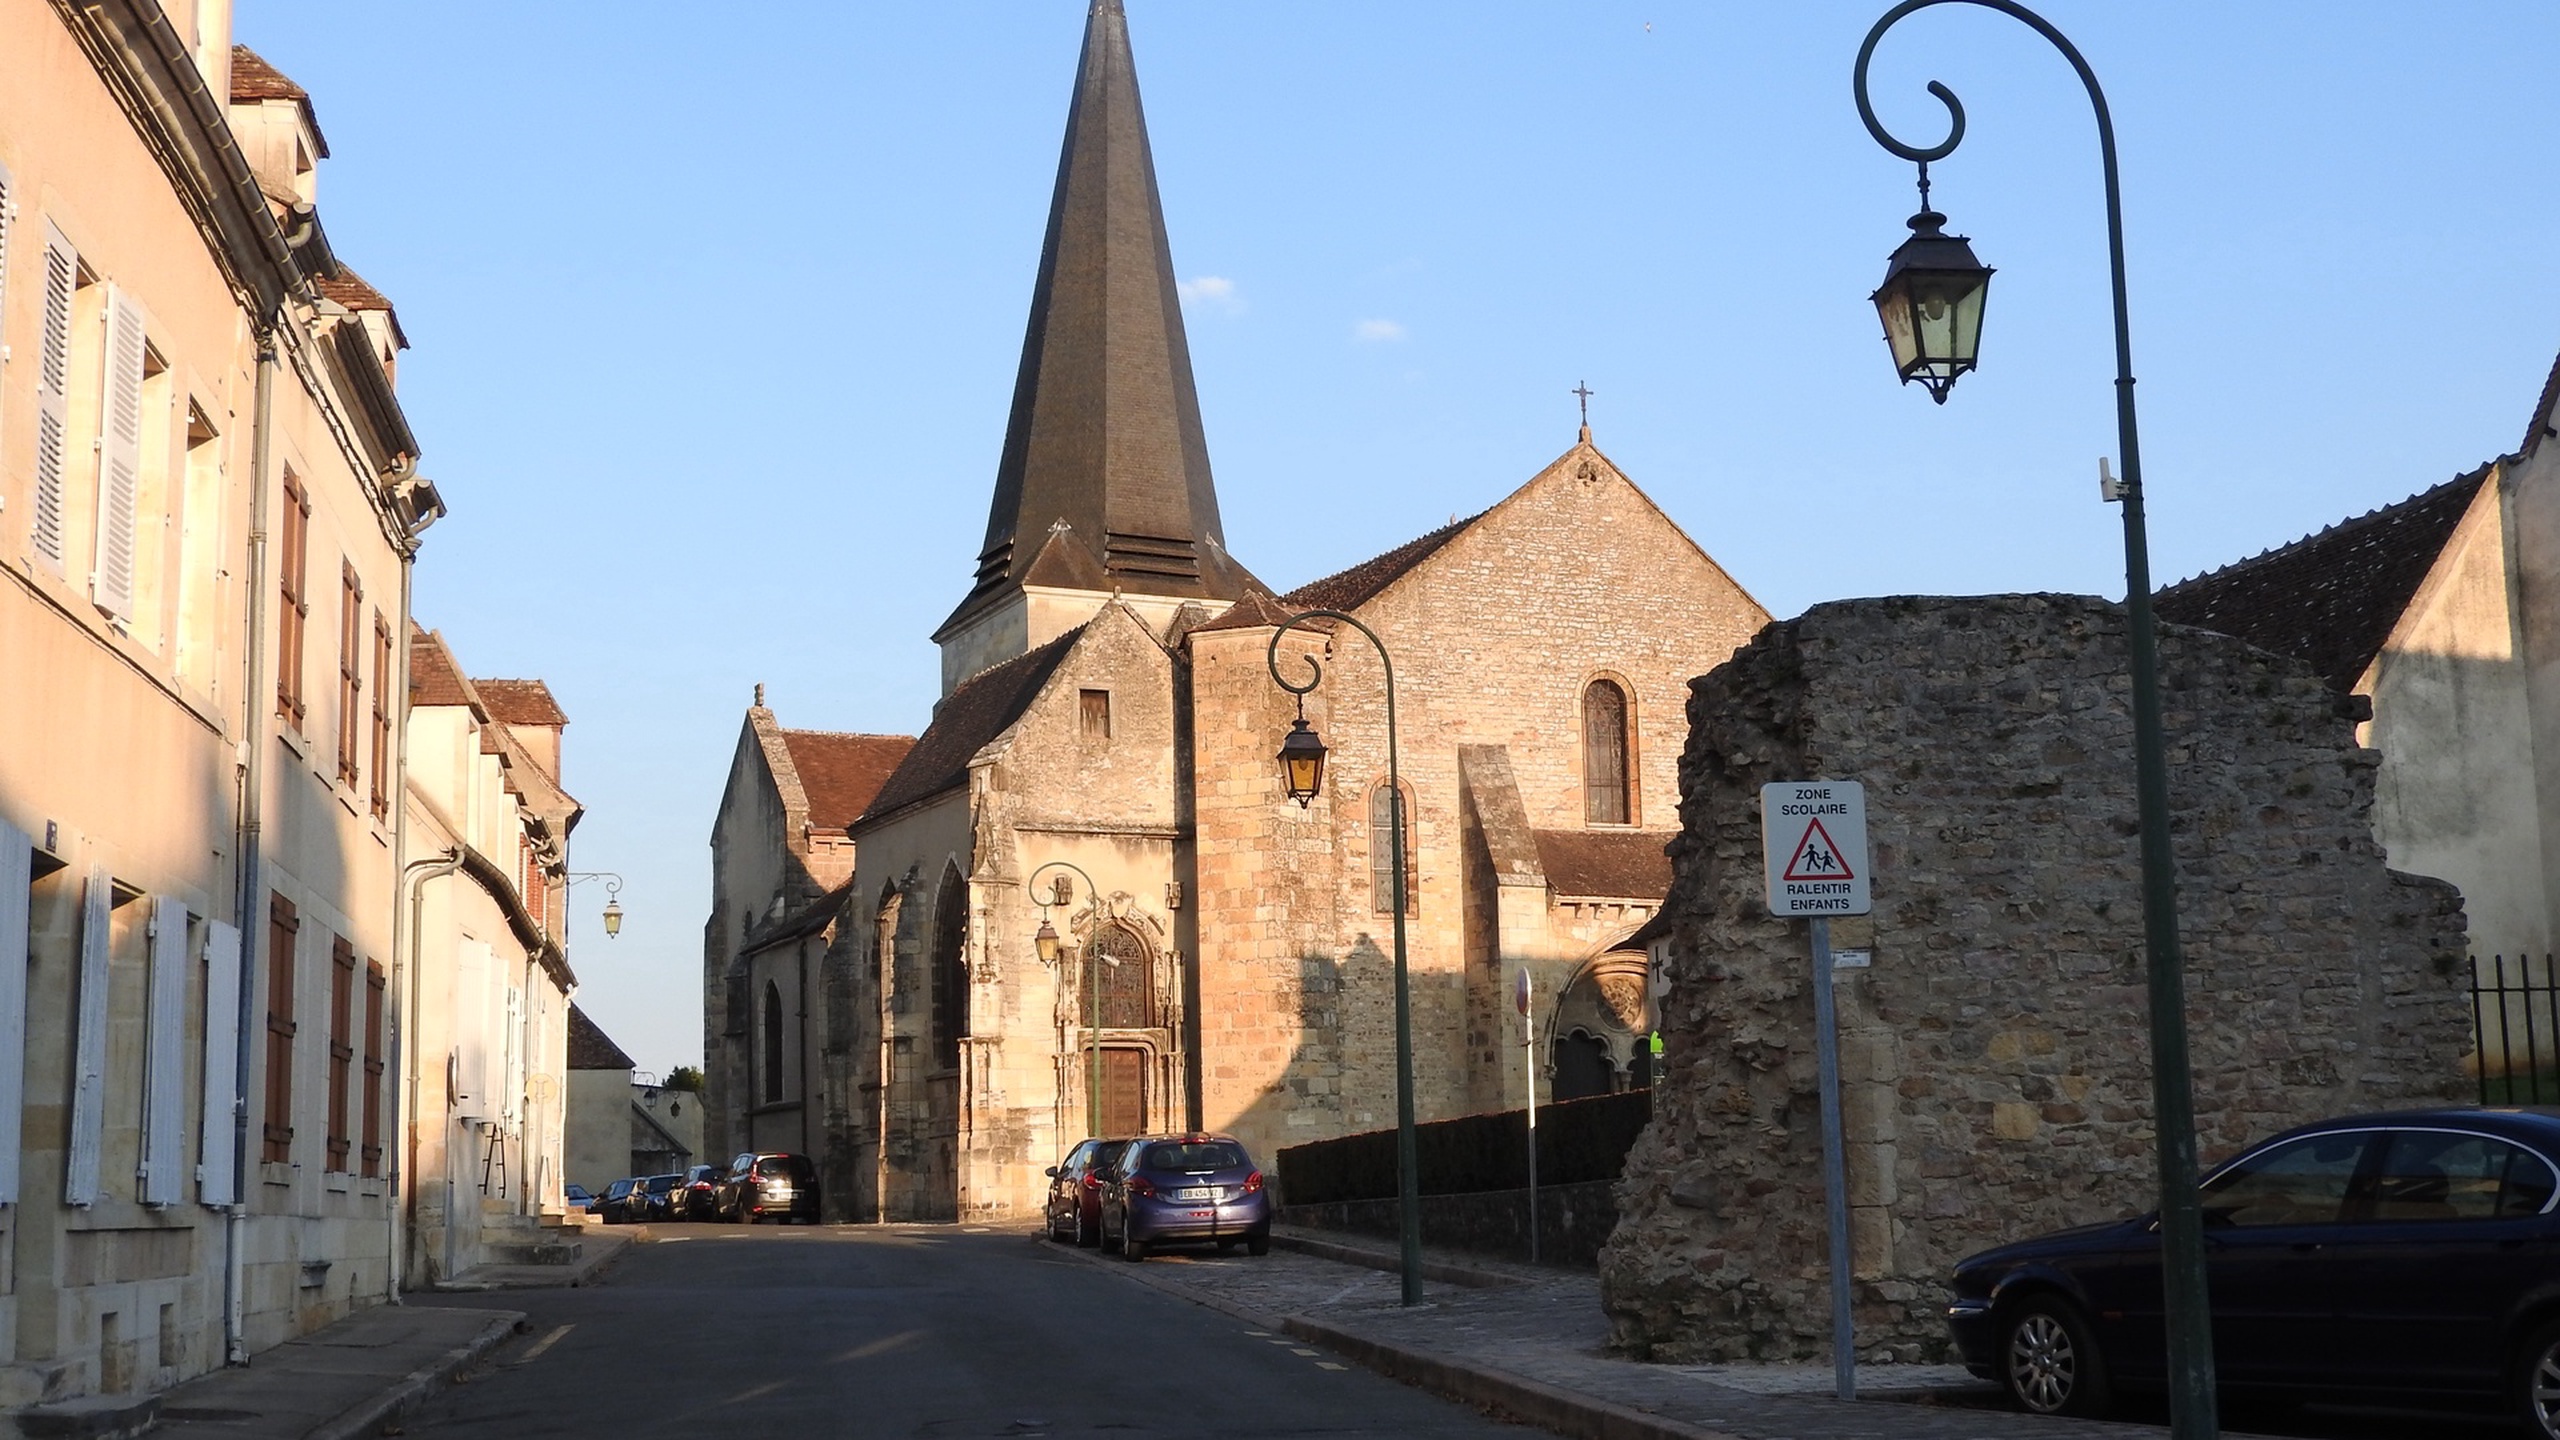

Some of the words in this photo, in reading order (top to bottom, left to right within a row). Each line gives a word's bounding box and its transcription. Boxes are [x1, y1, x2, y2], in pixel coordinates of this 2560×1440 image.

[1795, 789, 1831, 800] ZONE
[1781, 804, 1847, 815] SCOLAIRE
[1787, 883, 1851, 895] RALENTIR
[1790, 898, 1850, 910] ENFANTS
